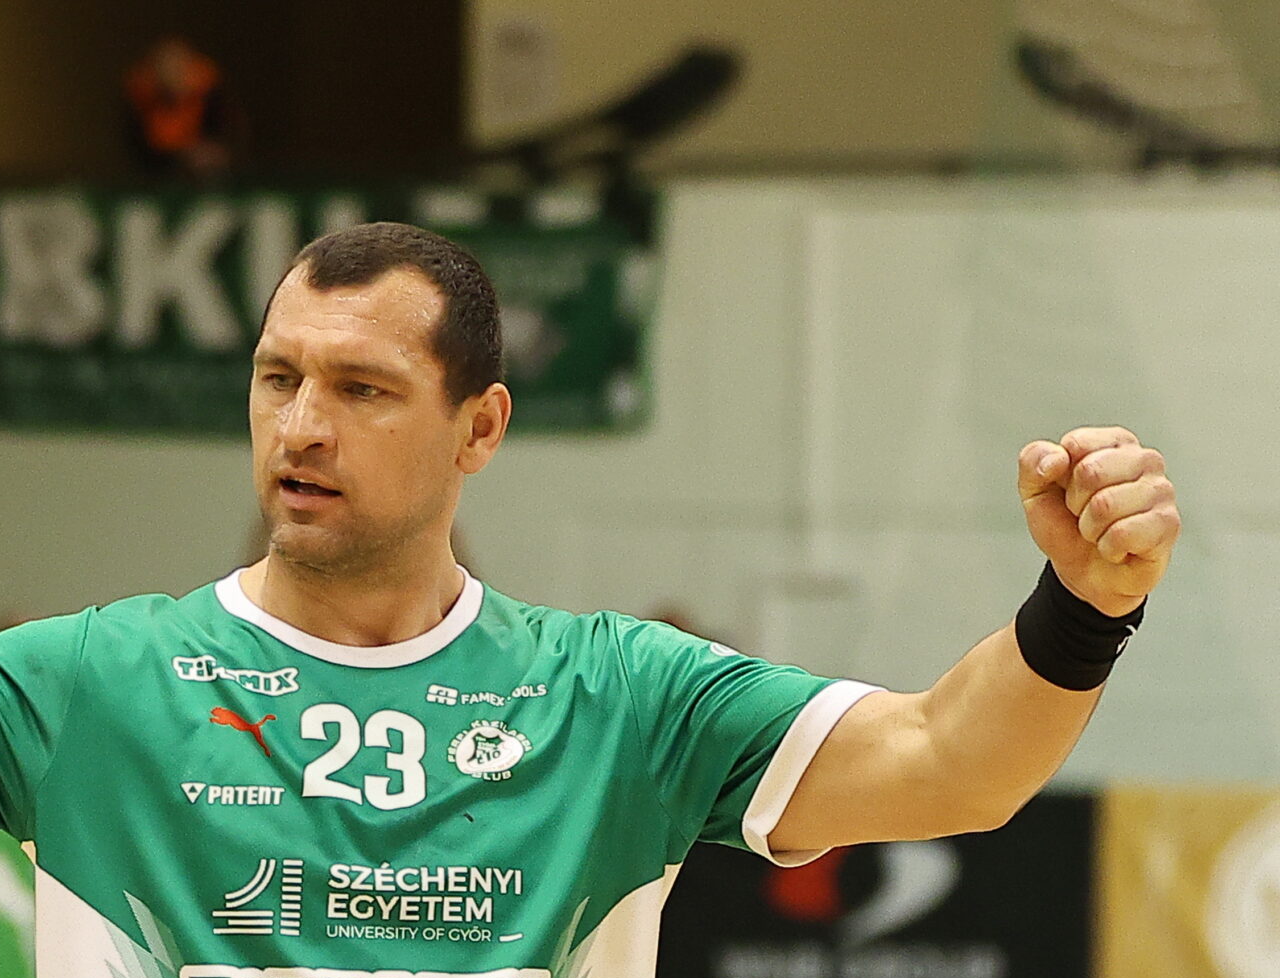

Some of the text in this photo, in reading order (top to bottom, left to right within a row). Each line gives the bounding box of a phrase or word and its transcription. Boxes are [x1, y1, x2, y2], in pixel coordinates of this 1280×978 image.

[461, 684, 547, 707] FAMEX OOLS
[300, 703, 426, 810] 23
[207, 786, 284, 805] PATENT
[328, 862, 522, 895] SZÉCHENYI
[327, 893, 494, 923] EGYETEM
[327, 926, 493, 942] UNIVERSITY OF GYŐR
